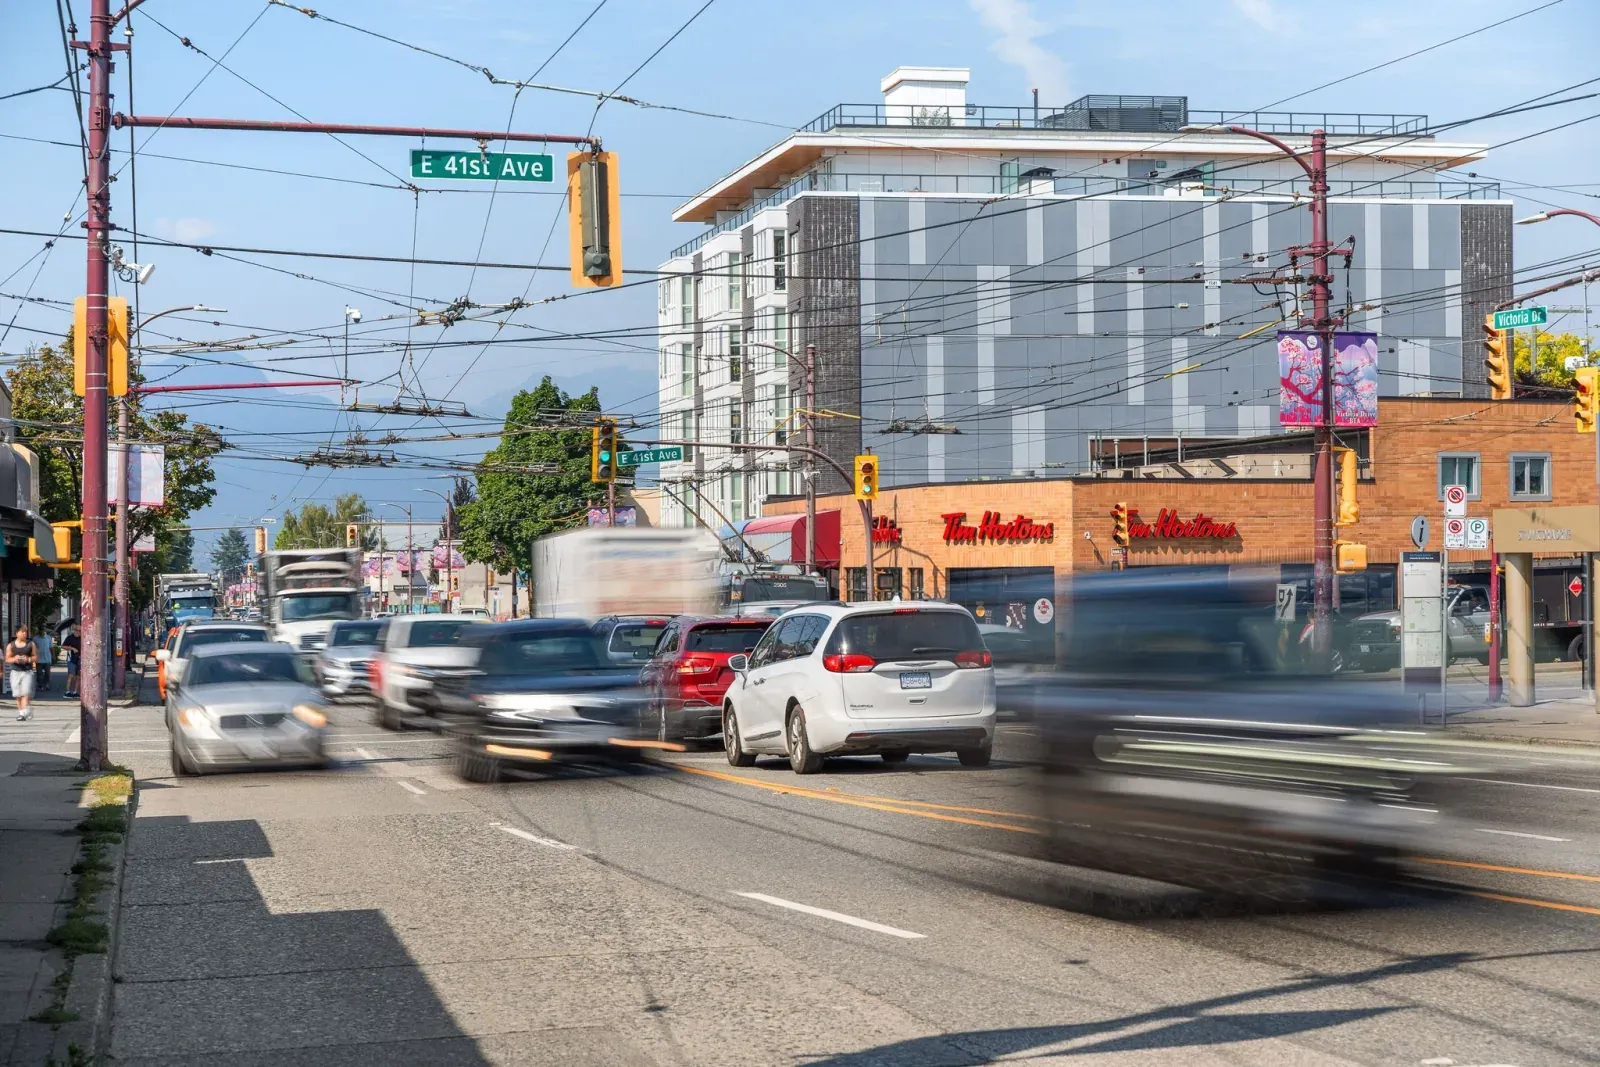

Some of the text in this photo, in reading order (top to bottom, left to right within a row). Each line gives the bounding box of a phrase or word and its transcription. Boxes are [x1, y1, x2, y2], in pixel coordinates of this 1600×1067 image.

[421, 155, 544, 178] E 41st Ave
[1498, 310, 1542, 327] Victoria Dr
[621, 450, 678, 464] E 41st Ave
[941, 510, 1054, 540] Tim Hortons
[1153, 507, 1236, 538] Hortons
[1474, 523, 1482, 531] P
